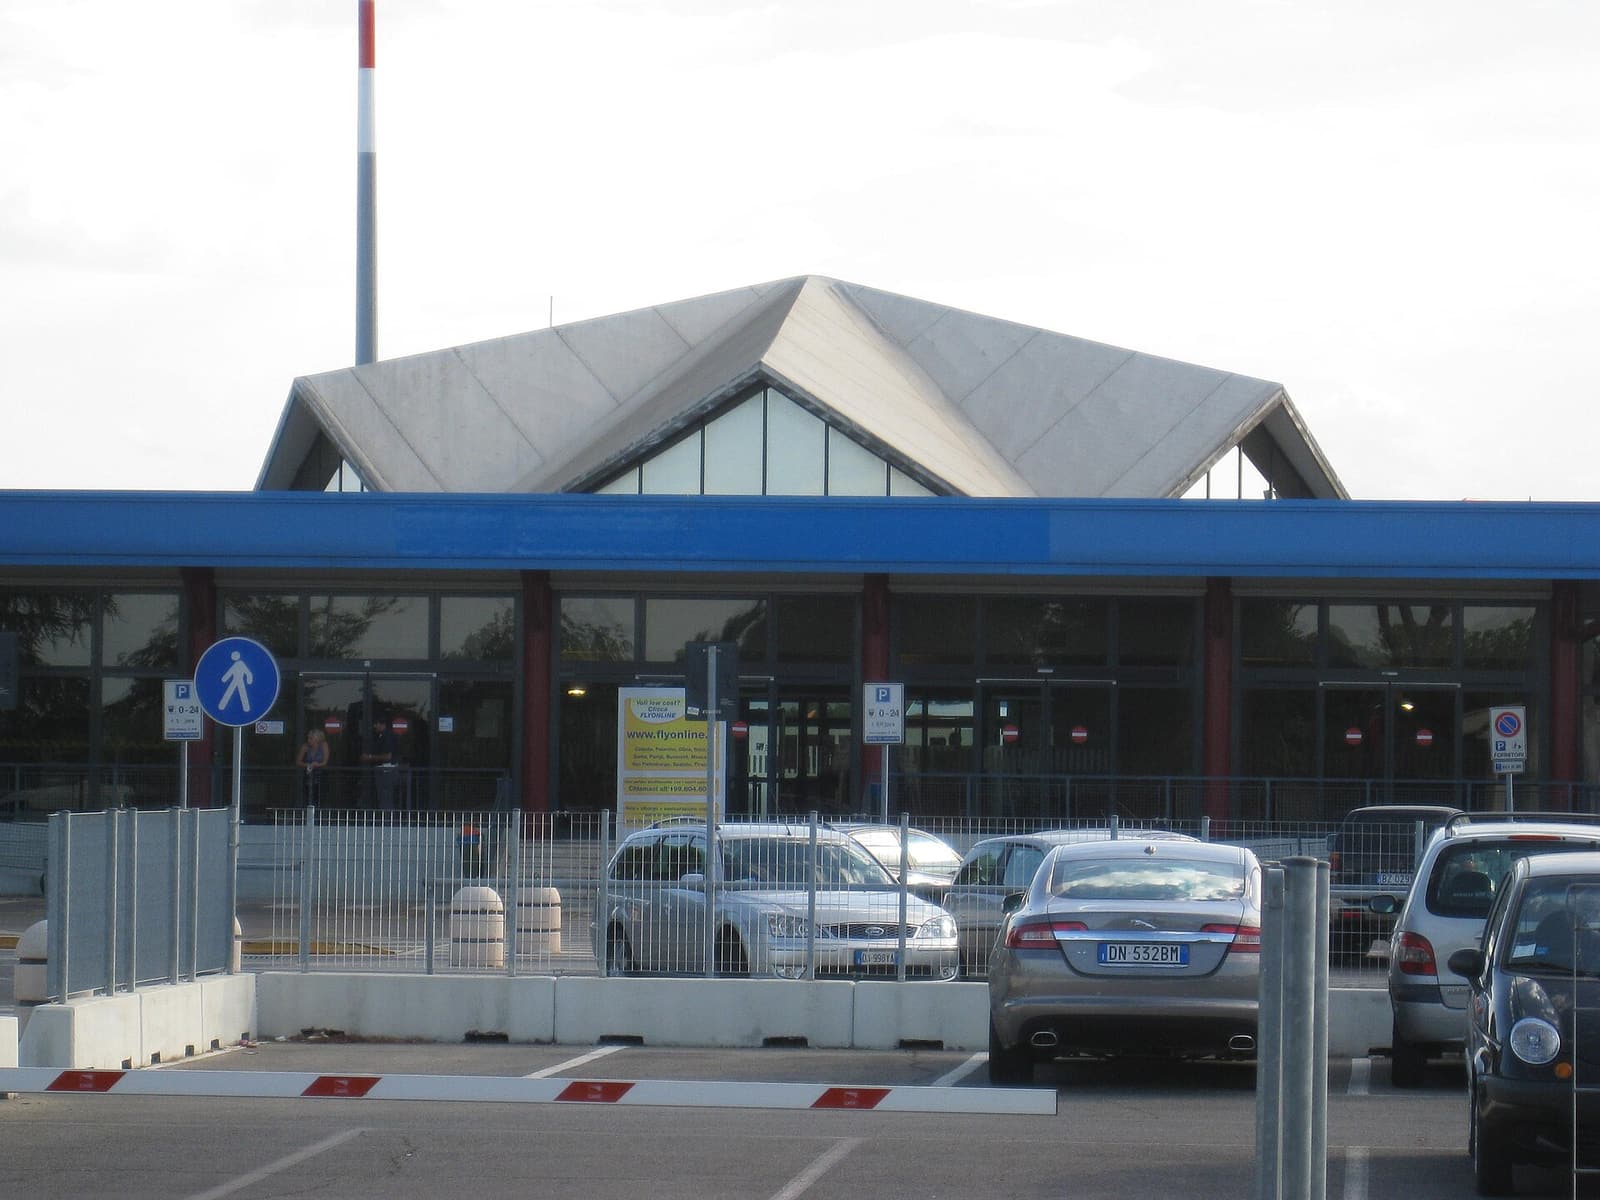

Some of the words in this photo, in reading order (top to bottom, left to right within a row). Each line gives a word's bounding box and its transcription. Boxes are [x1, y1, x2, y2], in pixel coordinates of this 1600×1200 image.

[178, 686, 187, 697] P
[879, 689, 888, 701] P
[1109, 946, 1127, 961] DN
[1133, 946, 1179, 961] 532BM
